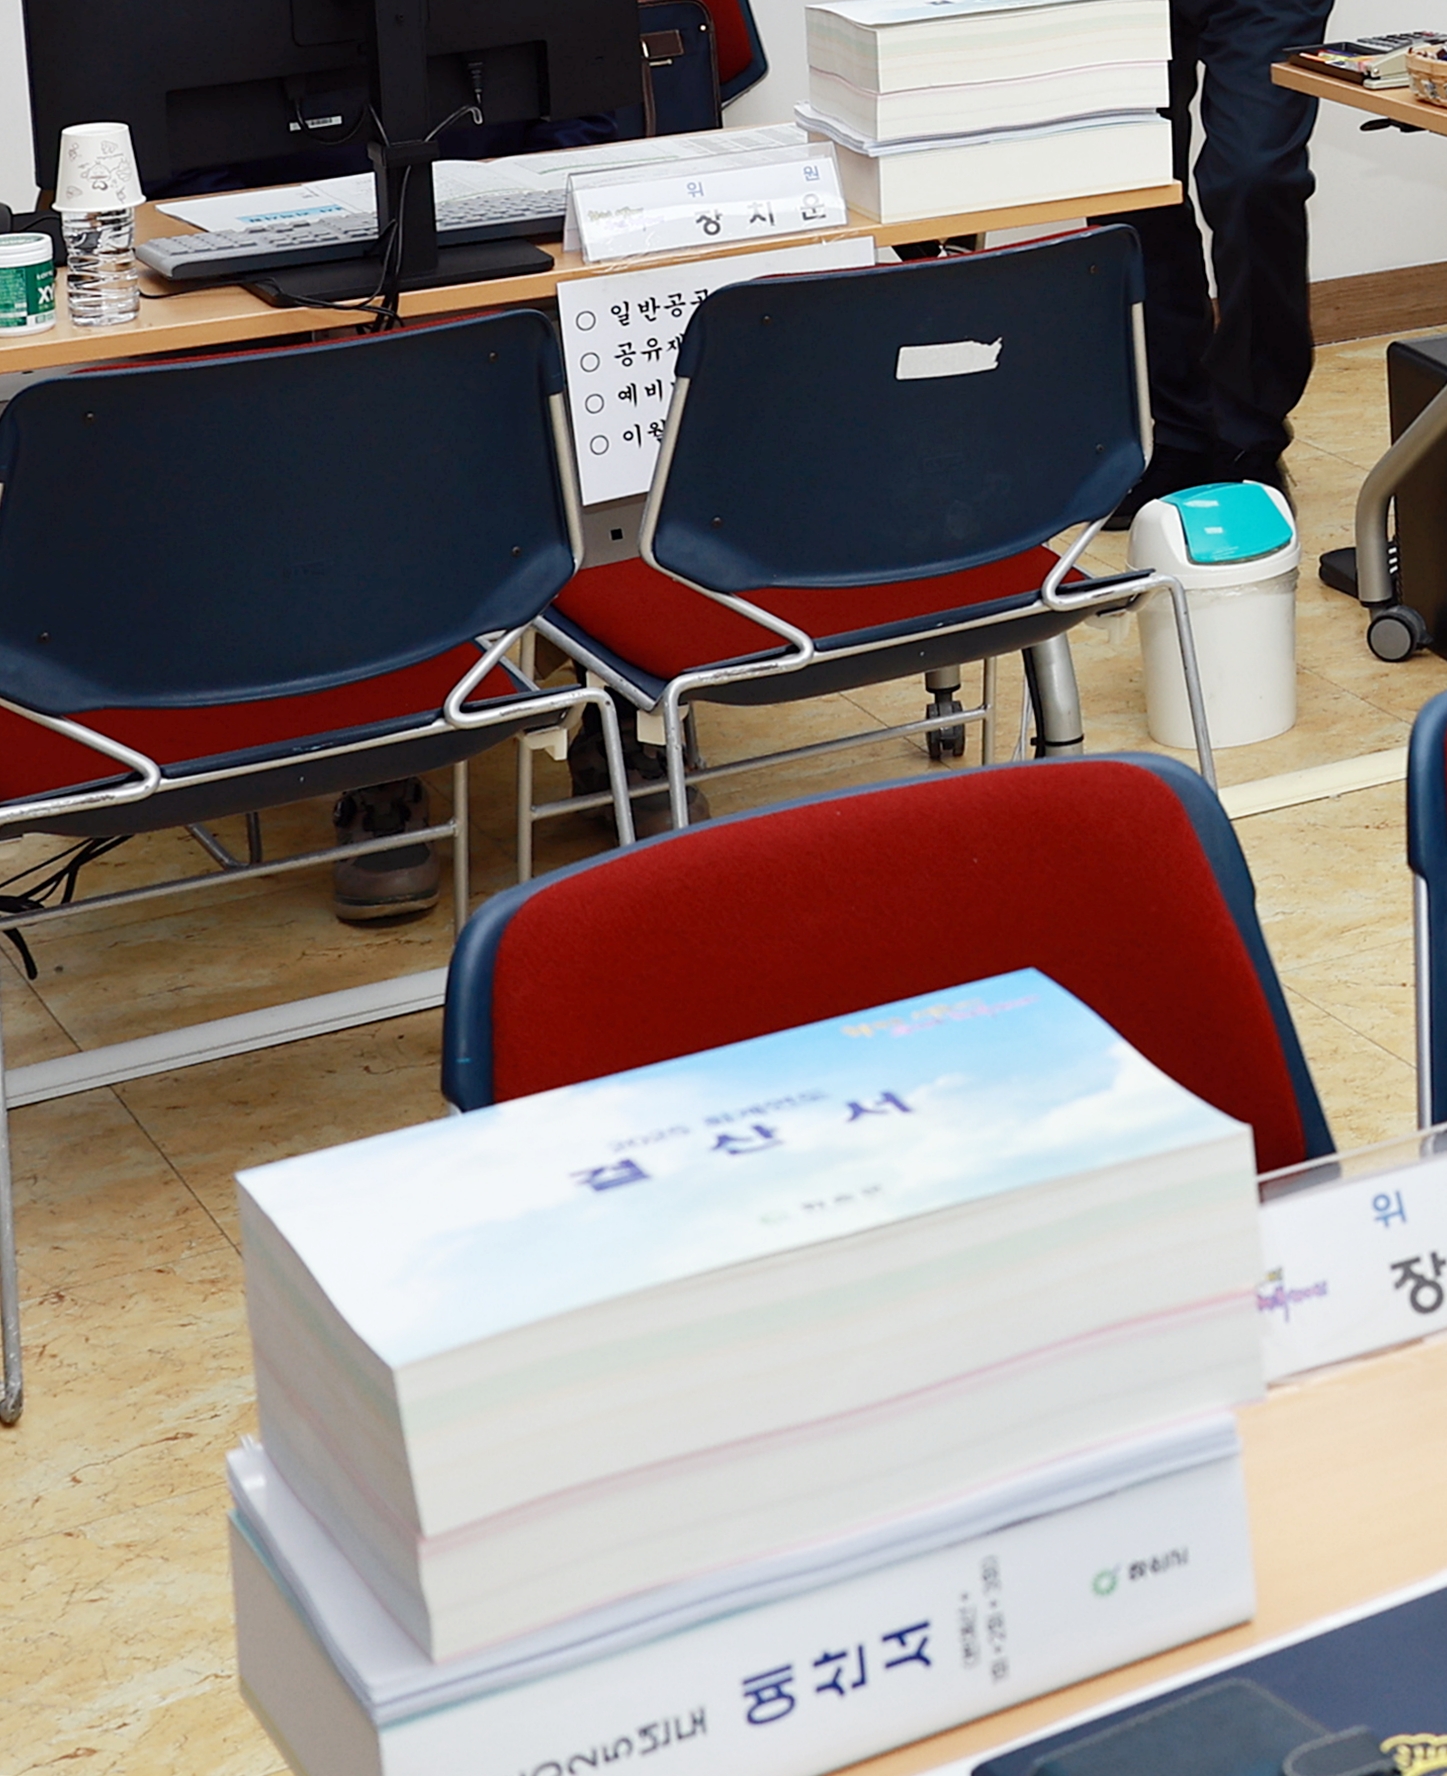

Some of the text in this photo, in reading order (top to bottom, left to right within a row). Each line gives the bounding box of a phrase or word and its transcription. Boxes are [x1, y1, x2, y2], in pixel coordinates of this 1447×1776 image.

[687, 165, 820, 198] 위 원
[1372, 1190, 1407, 1228] 위
[742, 1620, 931, 1725] 예산서
